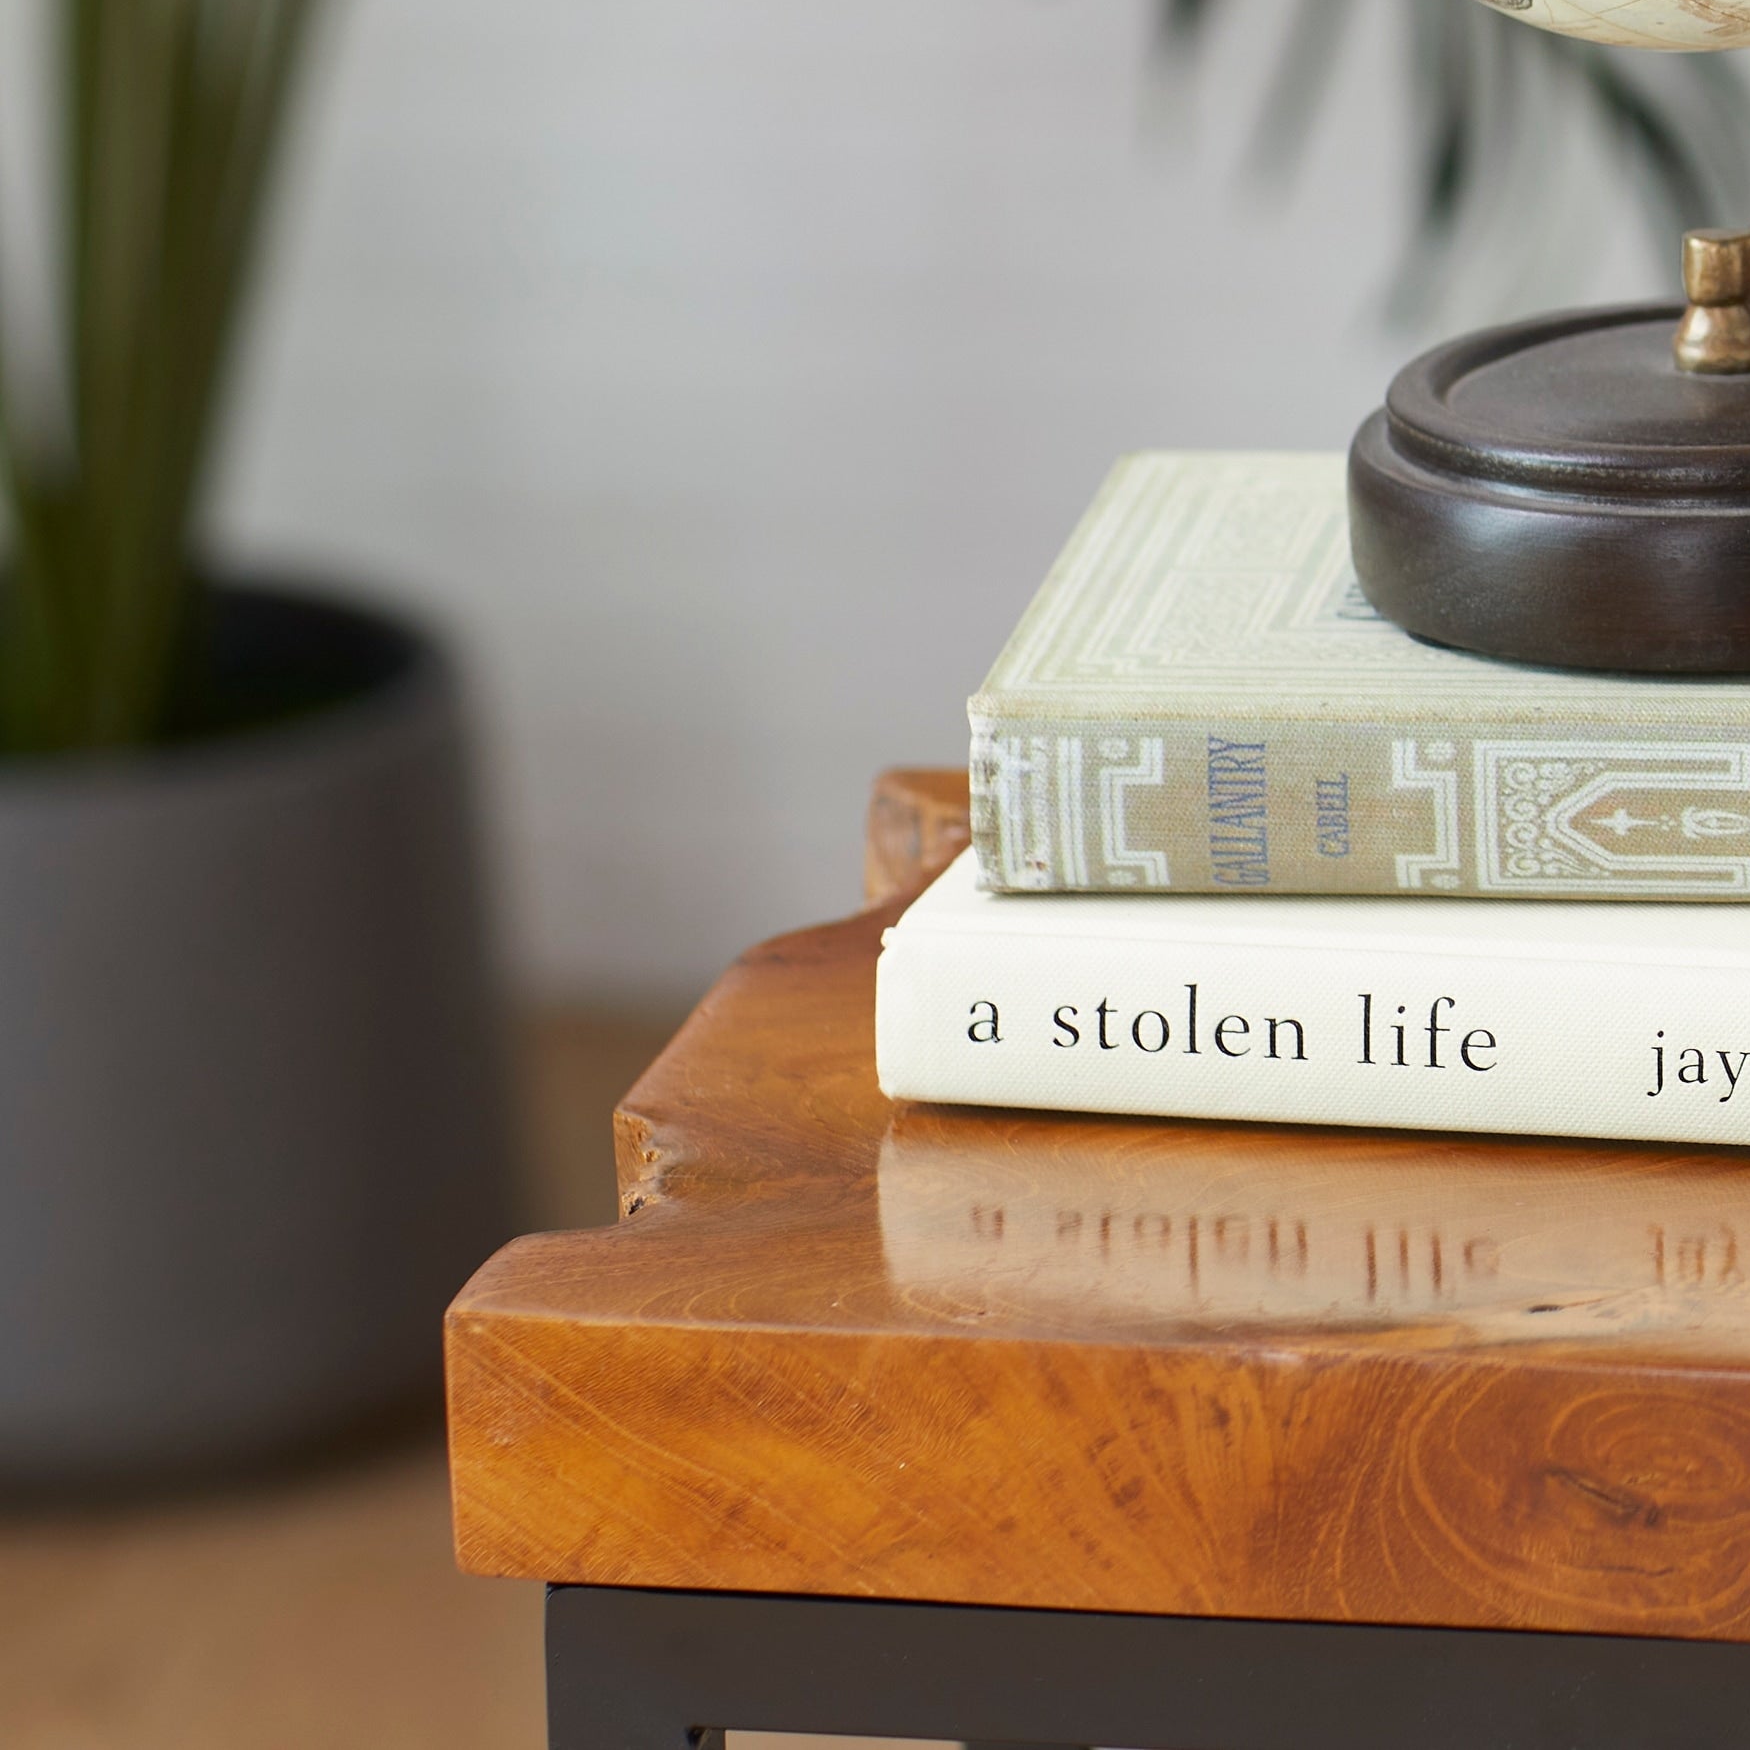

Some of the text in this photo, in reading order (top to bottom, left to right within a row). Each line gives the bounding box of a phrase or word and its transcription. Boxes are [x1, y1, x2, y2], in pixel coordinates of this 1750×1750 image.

[1208, 735, 1270, 888] GALLANTRY
[1315, 771, 1353, 860] CABELL
[967, 1000, 1005, 1046] a
[1052, 984, 1309, 1062] stolen
[1357, 992, 1498, 1072] life
